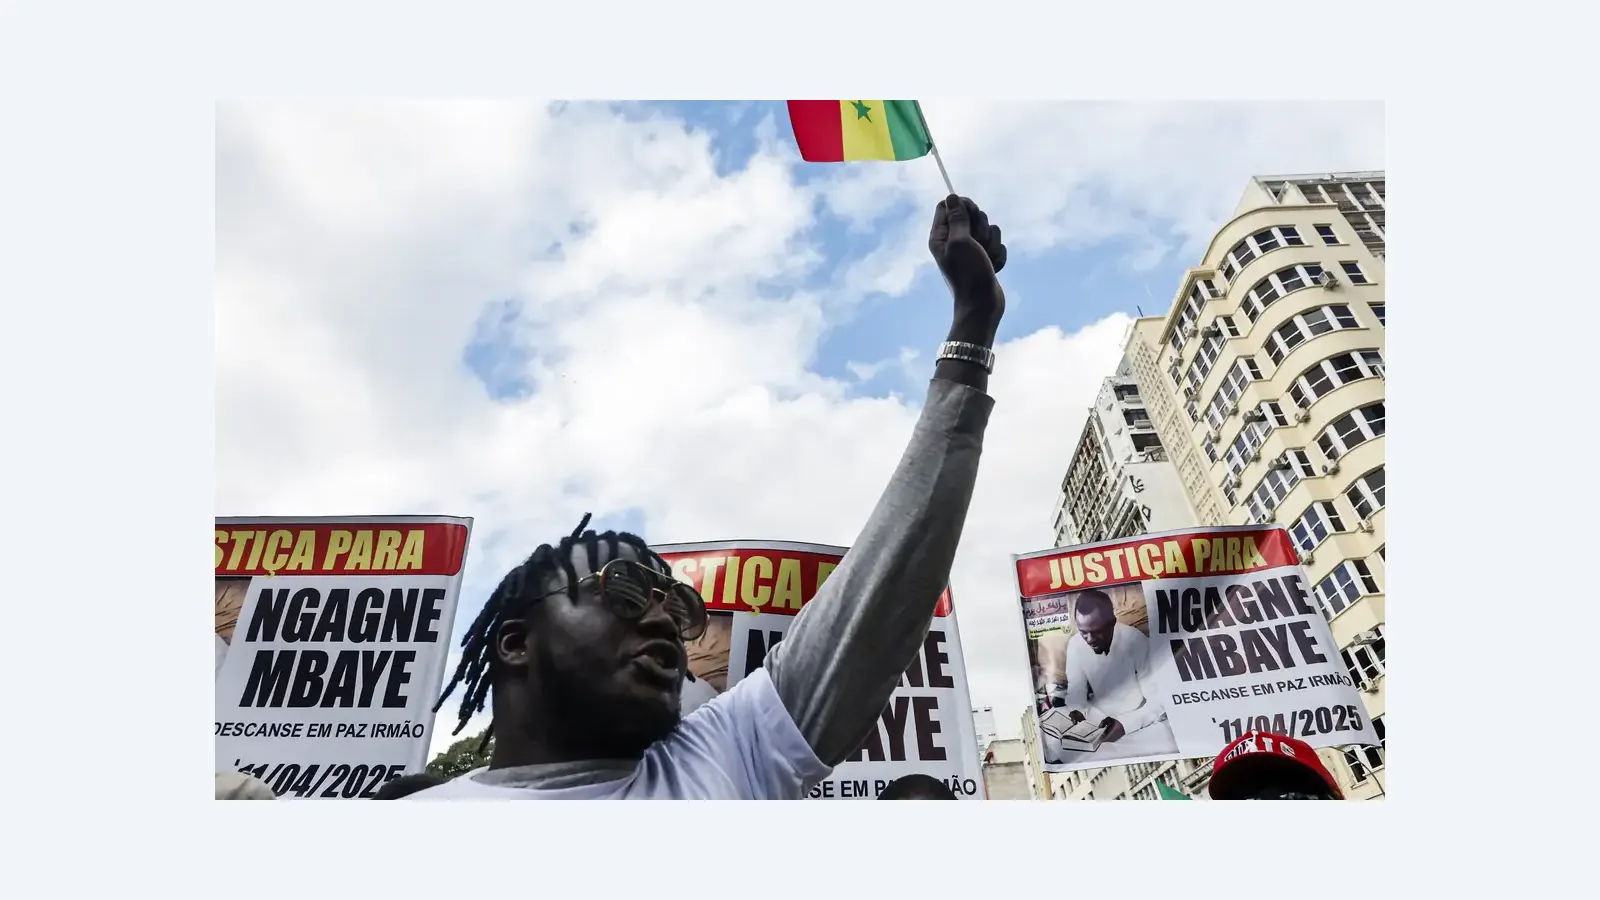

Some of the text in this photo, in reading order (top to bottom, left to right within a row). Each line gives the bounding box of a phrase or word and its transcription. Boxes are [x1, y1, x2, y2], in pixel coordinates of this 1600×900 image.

[322, 529, 425, 571] PARA
[1050, 536, 1269, 589] JUSTIÇA PARA
[667, 555, 803, 616] STIÇA
[1156, 575, 1317, 634] NGAGNE
[245, 587, 446, 643] NGAGNE
[1170, 621, 1328, 682] MBAYE
[239, 650, 416, 708] MBAYE
[1172, 671, 1352, 705] DESCANSE EM PAZ IRMÃO
[215, 720, 424, 738] DESCANSE EM PAZ IRMÃO
[840, 780, 868, 797] EM
